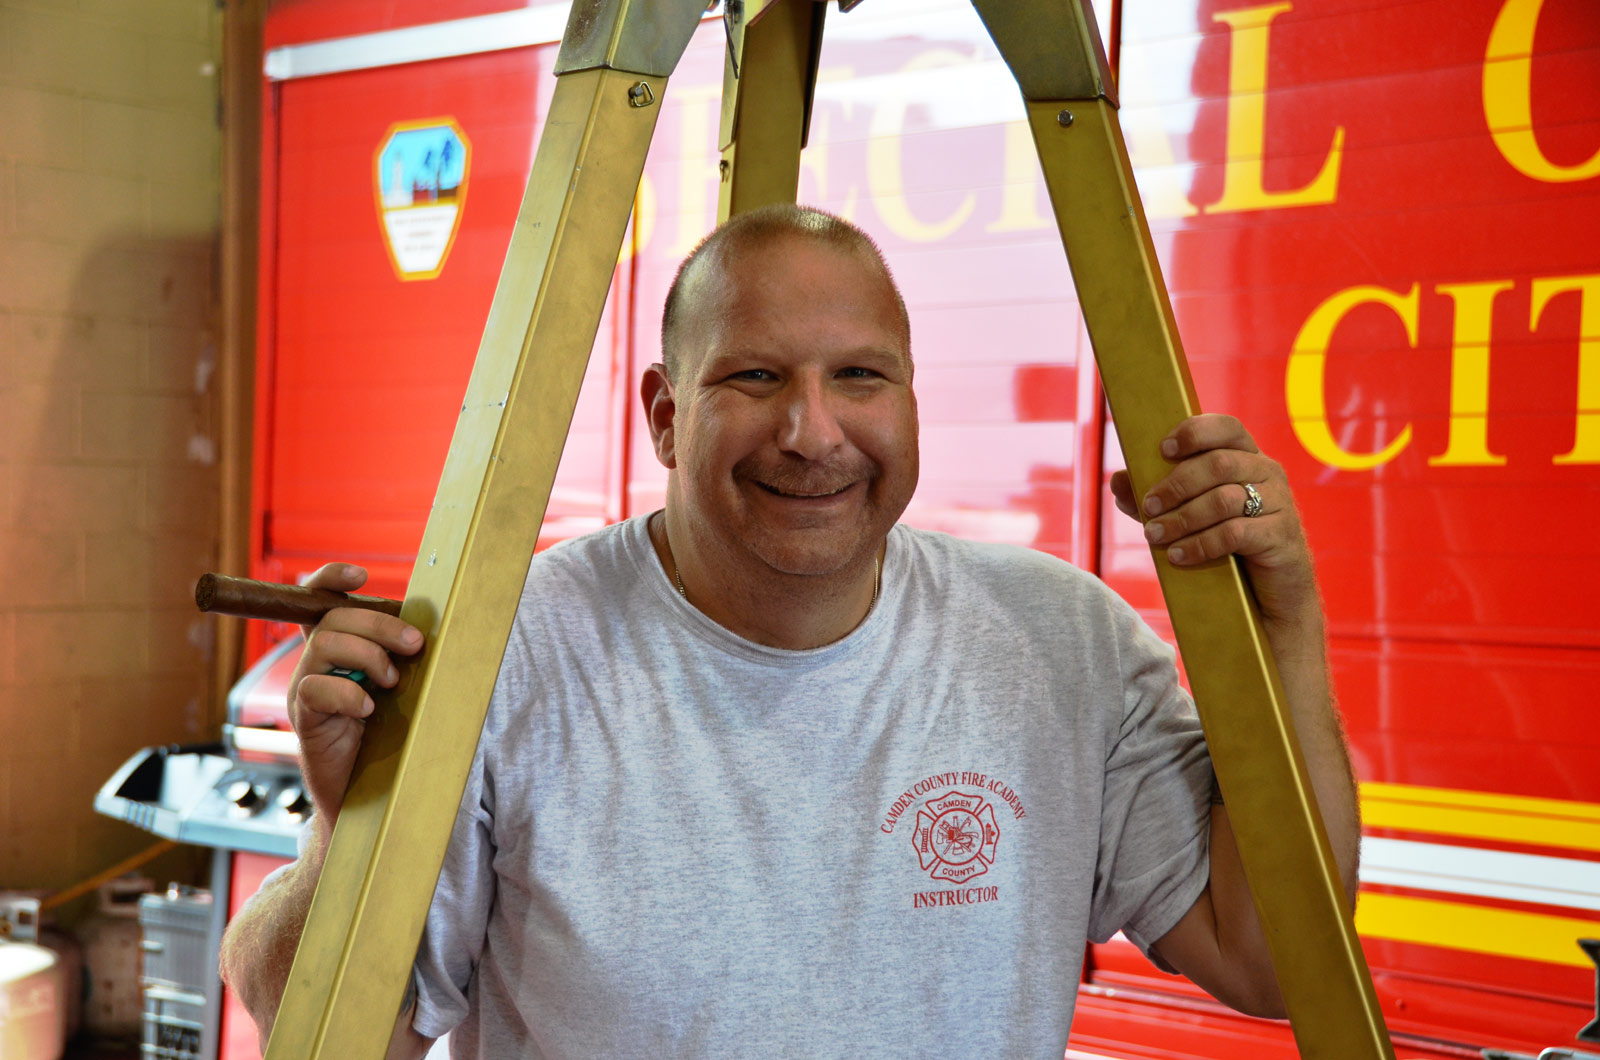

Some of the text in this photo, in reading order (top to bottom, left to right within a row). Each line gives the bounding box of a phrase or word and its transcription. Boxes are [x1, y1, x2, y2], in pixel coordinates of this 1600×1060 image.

[880, 771, 1028, 835] CAMDEN COUNTY FIRE ACADEMY
[936, 799, 972, 811] CAMDEN
[942, 865, 976, 877] COUNTY
[913, 885, 999, 909] INSTRUCTOR
